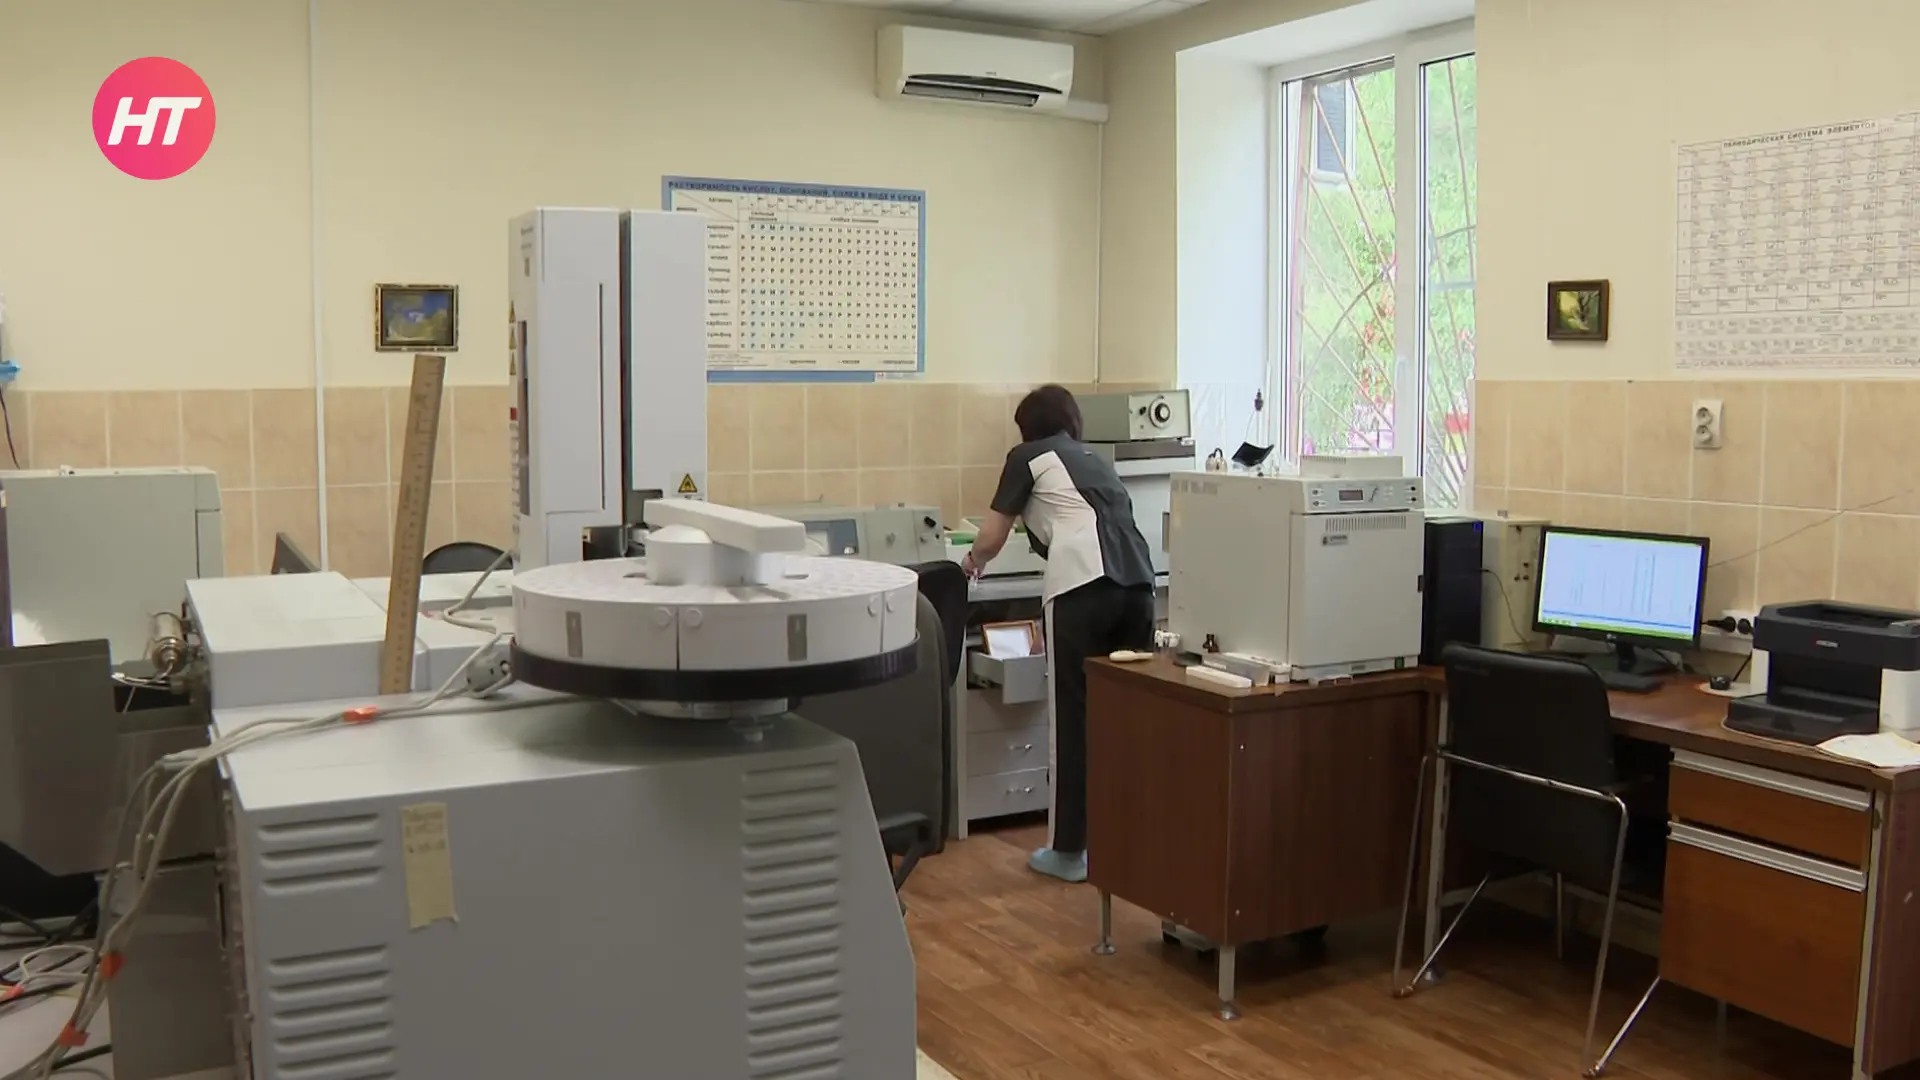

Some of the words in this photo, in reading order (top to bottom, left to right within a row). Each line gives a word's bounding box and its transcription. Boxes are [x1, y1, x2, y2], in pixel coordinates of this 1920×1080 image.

[1723, 134, 1785, 148] ПЕРИОДИЧЕСКАЯ
[1787, 129, 1823, 140] СИСТЕМА
[1827, 121, 1876, 135] ЭЛЕМЕНТОВ
[668, 181, 740, 192] РАСТВОРИМОСТЬ
